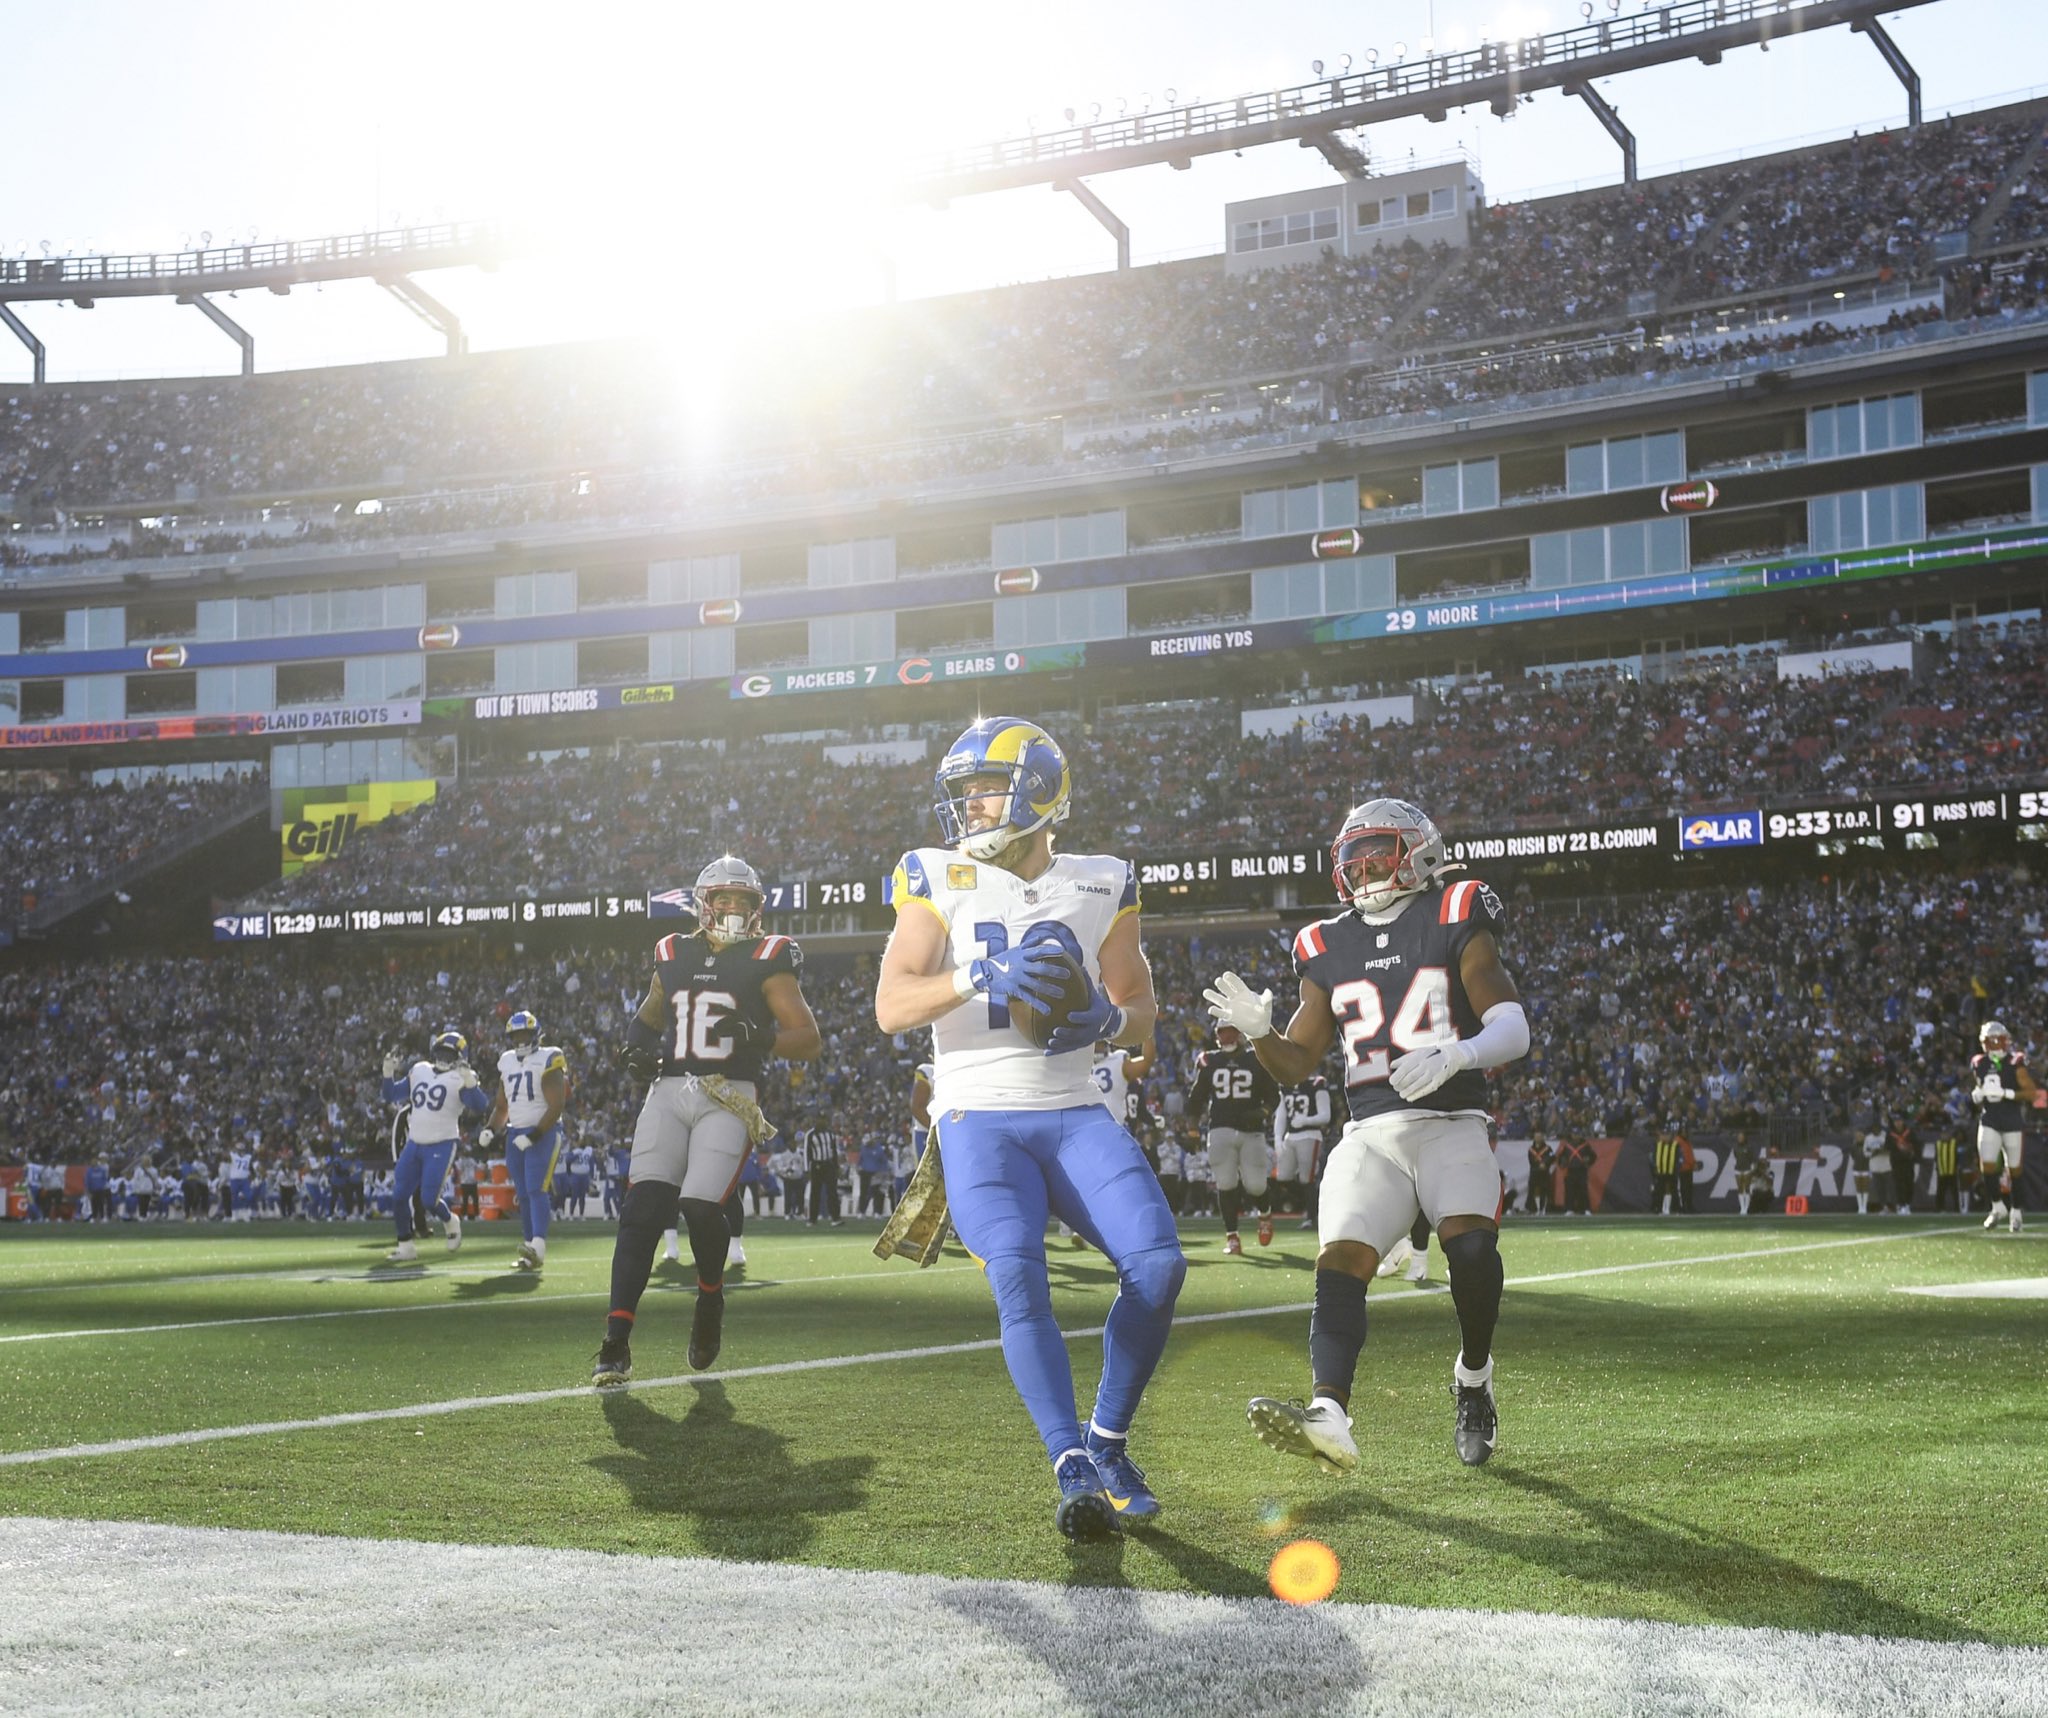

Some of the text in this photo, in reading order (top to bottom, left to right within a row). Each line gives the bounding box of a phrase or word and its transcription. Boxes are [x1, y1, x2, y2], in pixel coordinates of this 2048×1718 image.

[1385, 604, 1479, 632] 29 MOORE
[1150, 630, 1253, 656] RECEIVING YDS
[945, 657, 996, 676] BEARS
[1004, 652, 1020, 671] 0
[741, 666, 877, 698] G PACKERS 7
[475, 689, 599, 719] OUT OF TOWN SCORES
[313, 708, 388, 727] PATRIOTS
[7, 723, 128, 744] ENGLAND PATRI
[1769, 811, 1871, 838] 9:33 T.O.P.
[1893, 800, 1997, 829] 91 PASS YDS
[288, 813, 374, 857] Gill
[1711, 819, 1753, 842] LAR
[1454, 842, 1465, 860] 0
[1466, 839, 1505, 860] YARD
[1507, 836, 1546, 857] RUSH
[1547, 834, 1567, 854] BY
[1569, 832, 1588, 852] 22
[1589, 827, 1658, 850] B.CORUM
[1141, 861, 1210, 884] 2ND & 5
[1231, 855, 1307, 878] BALL ON 5
[771, 887, 784, 907] 7
[820, 882, 866, 904] 7:18
[1077, 885, 1111, 896] RAMS
[437, 906, 510, 926] 43 RUSH YDS
[523, 901, 591, 922] 8 1ST DOWNS
[606, 897, 645, 917] 3 PEN.
[242, 916, 264, 936] NE
[273, 913, 342, 935] 12:29 T.O.P.
[352, 910, 424, 930] 118 PASS YDS
[1364, 954, 1401, 971] PATRIOTS
[671, 990, 737, 1060] 16
[1330, 966, 1460, 1088] 24
[508, 1070, 535, 1103] 71
[1091, 1067, 1113, 1094] 3
[1212, 1068, 1253, 1099] 92
[412, 1081, 447, 1112] 69
